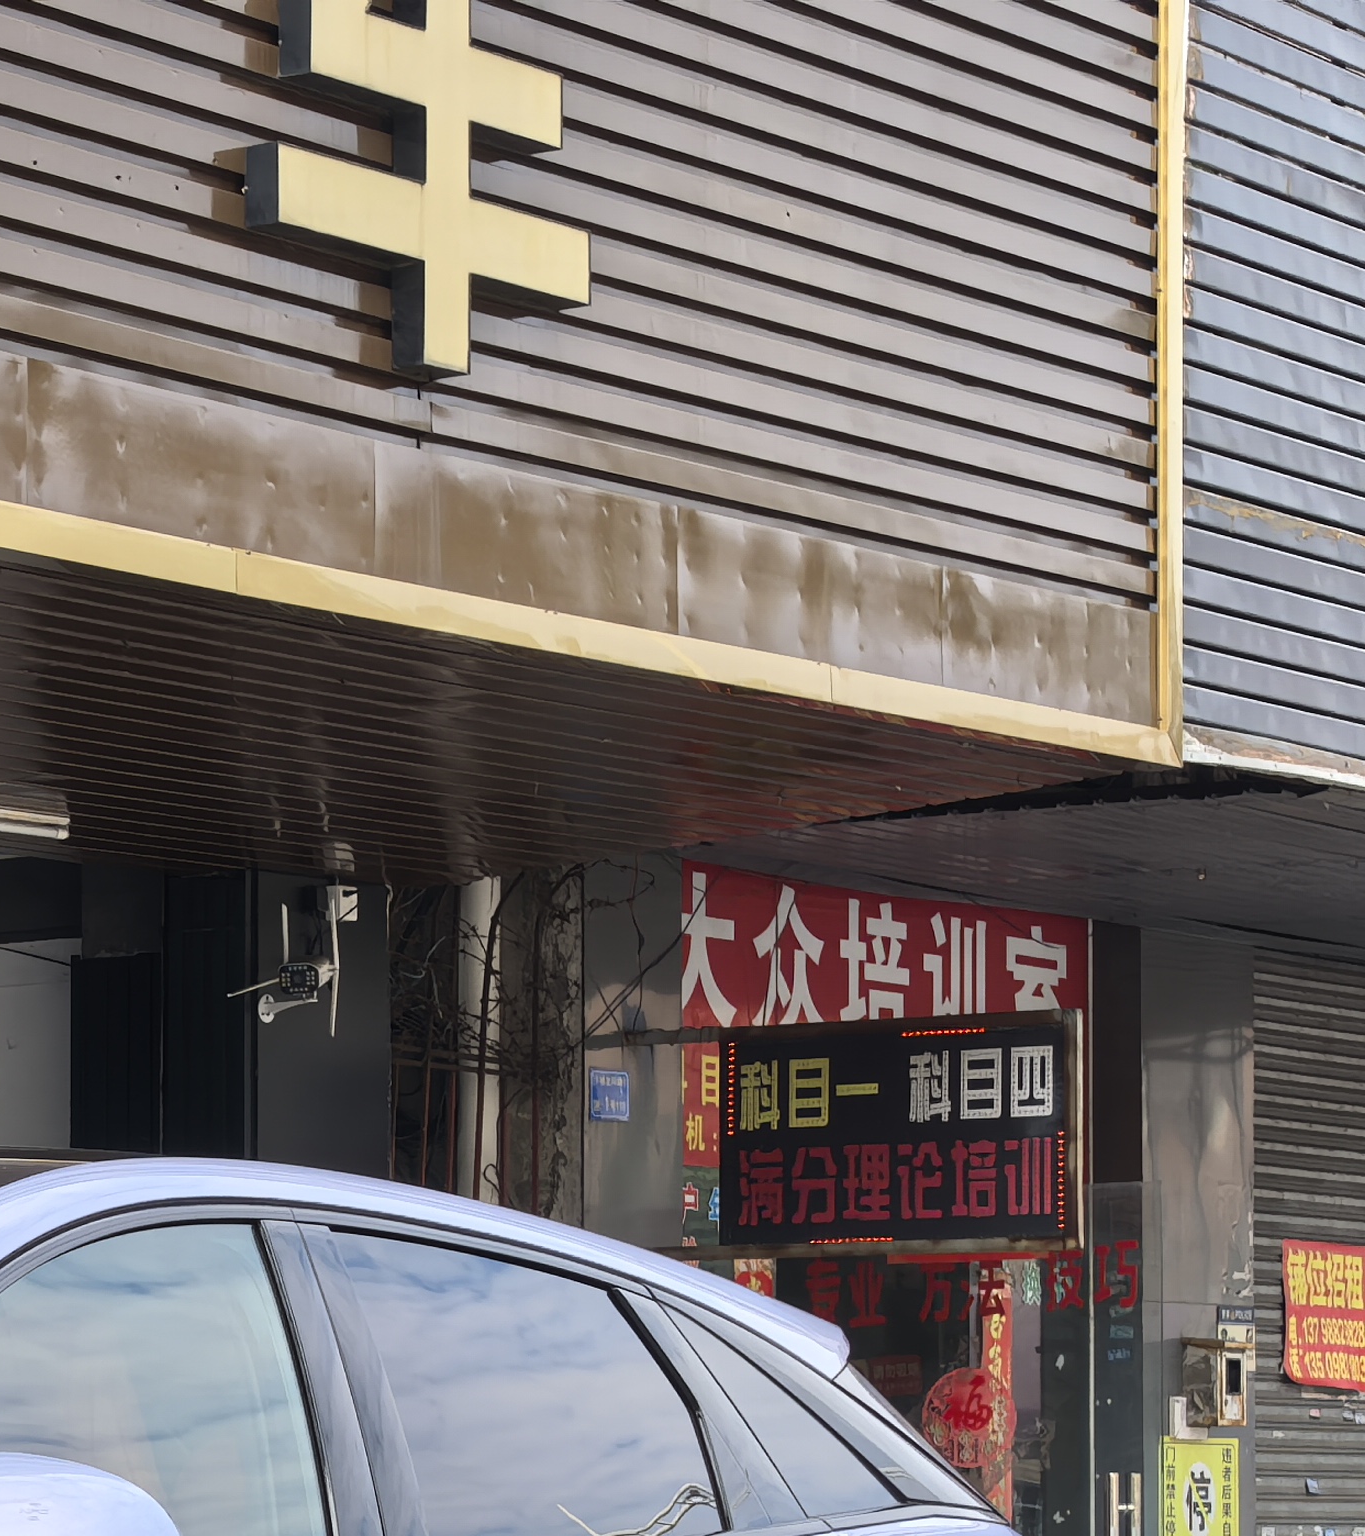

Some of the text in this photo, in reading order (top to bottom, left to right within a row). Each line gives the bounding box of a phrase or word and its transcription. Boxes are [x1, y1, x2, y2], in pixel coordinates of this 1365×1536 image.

[682, 870, 1068, 1027] 大众培训室
[739, 1045, 1054, 1132] 科目一 科目四
[738, 1136, 1053, 1226] 满分理论培训
[1186, 1469, 1212, 1532] 停
